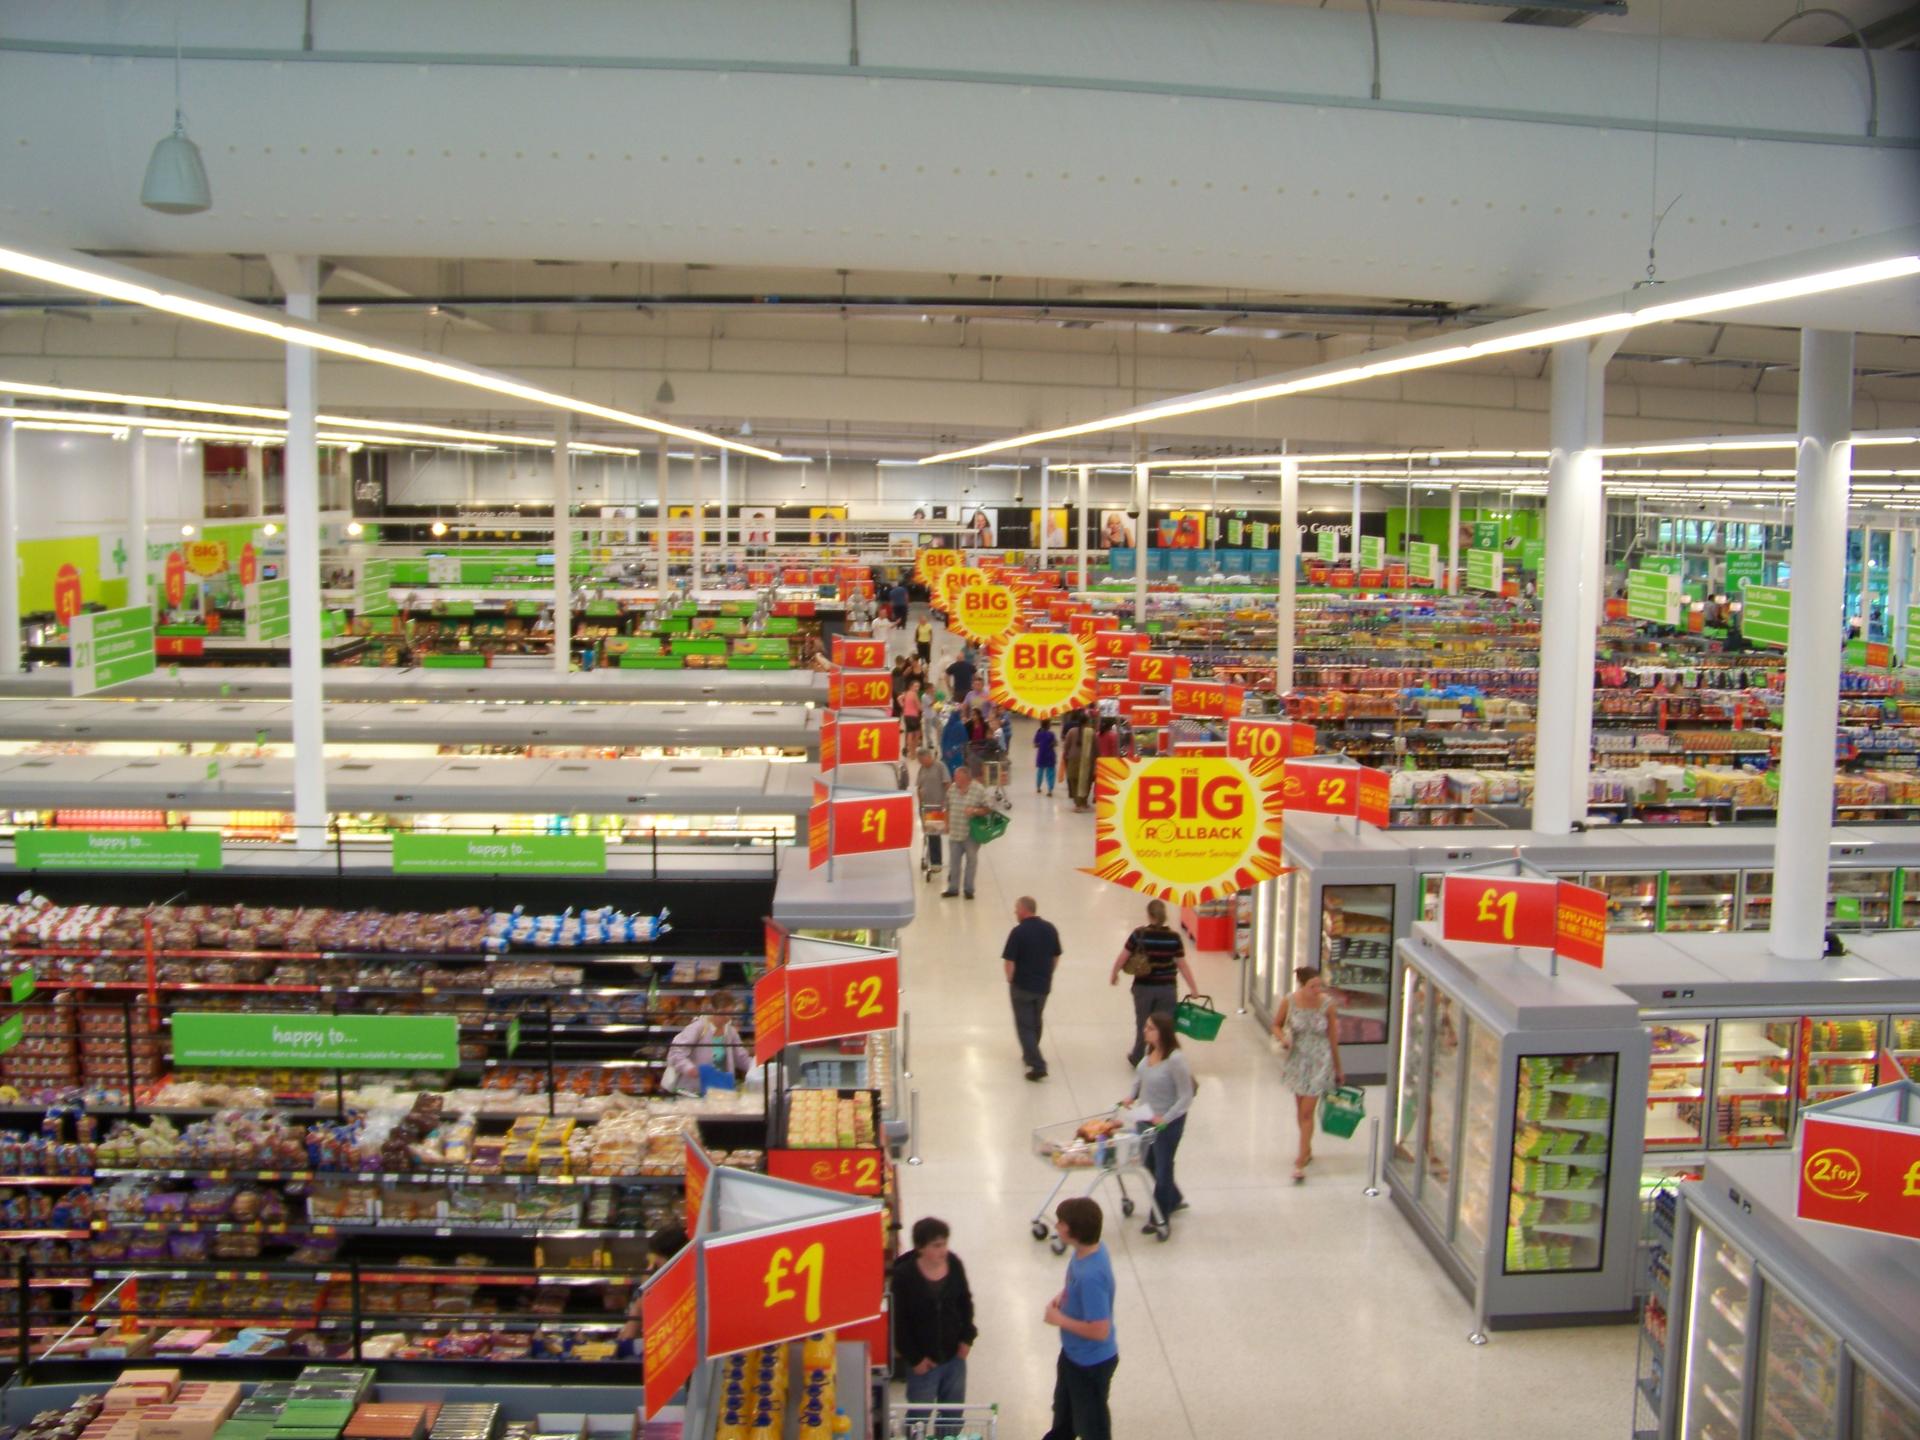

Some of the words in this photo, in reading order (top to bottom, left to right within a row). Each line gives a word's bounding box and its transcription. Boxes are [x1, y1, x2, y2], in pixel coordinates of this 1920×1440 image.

[194, 546, 217, 557] BIG
[926, 554, 955, 567] BIG
[946, 574, 981, 588] BIG
[966, 593, 1008, 610] BIG
[856, 646, 875, 666] £2
[1014, 644, 1074, 670] BIG
[1141, 658, 1163, 680] £2
[864, 680, 889, 700] £10
[858, 728, 880, 759] £1
[1237, 726, 1282, 757] £10
[1181, 767, 1199, 775] THE
[1138, 775, 1244, 820] BIG
[1318, 778, 1346, 806] £2
[862, 808, 887, 842] £1
[1145, 827, 1242, 842] ROLLBACK
[88, 834, 127, 849] happy
[467, 841, 507, 856] happy
[511, 842, 533, 855] to...
[1175, 848, 1206, 858] Summer
[1477, 888, 1518, 940] £1
[845, 975, 883, 1018] £2
[271, 1026, 324, 1048] happy
[328, 1027, 358, 1044] to...
[1812, 1157, 1856, 1181] 2for
[764, 1242, 825, 1323] £1
